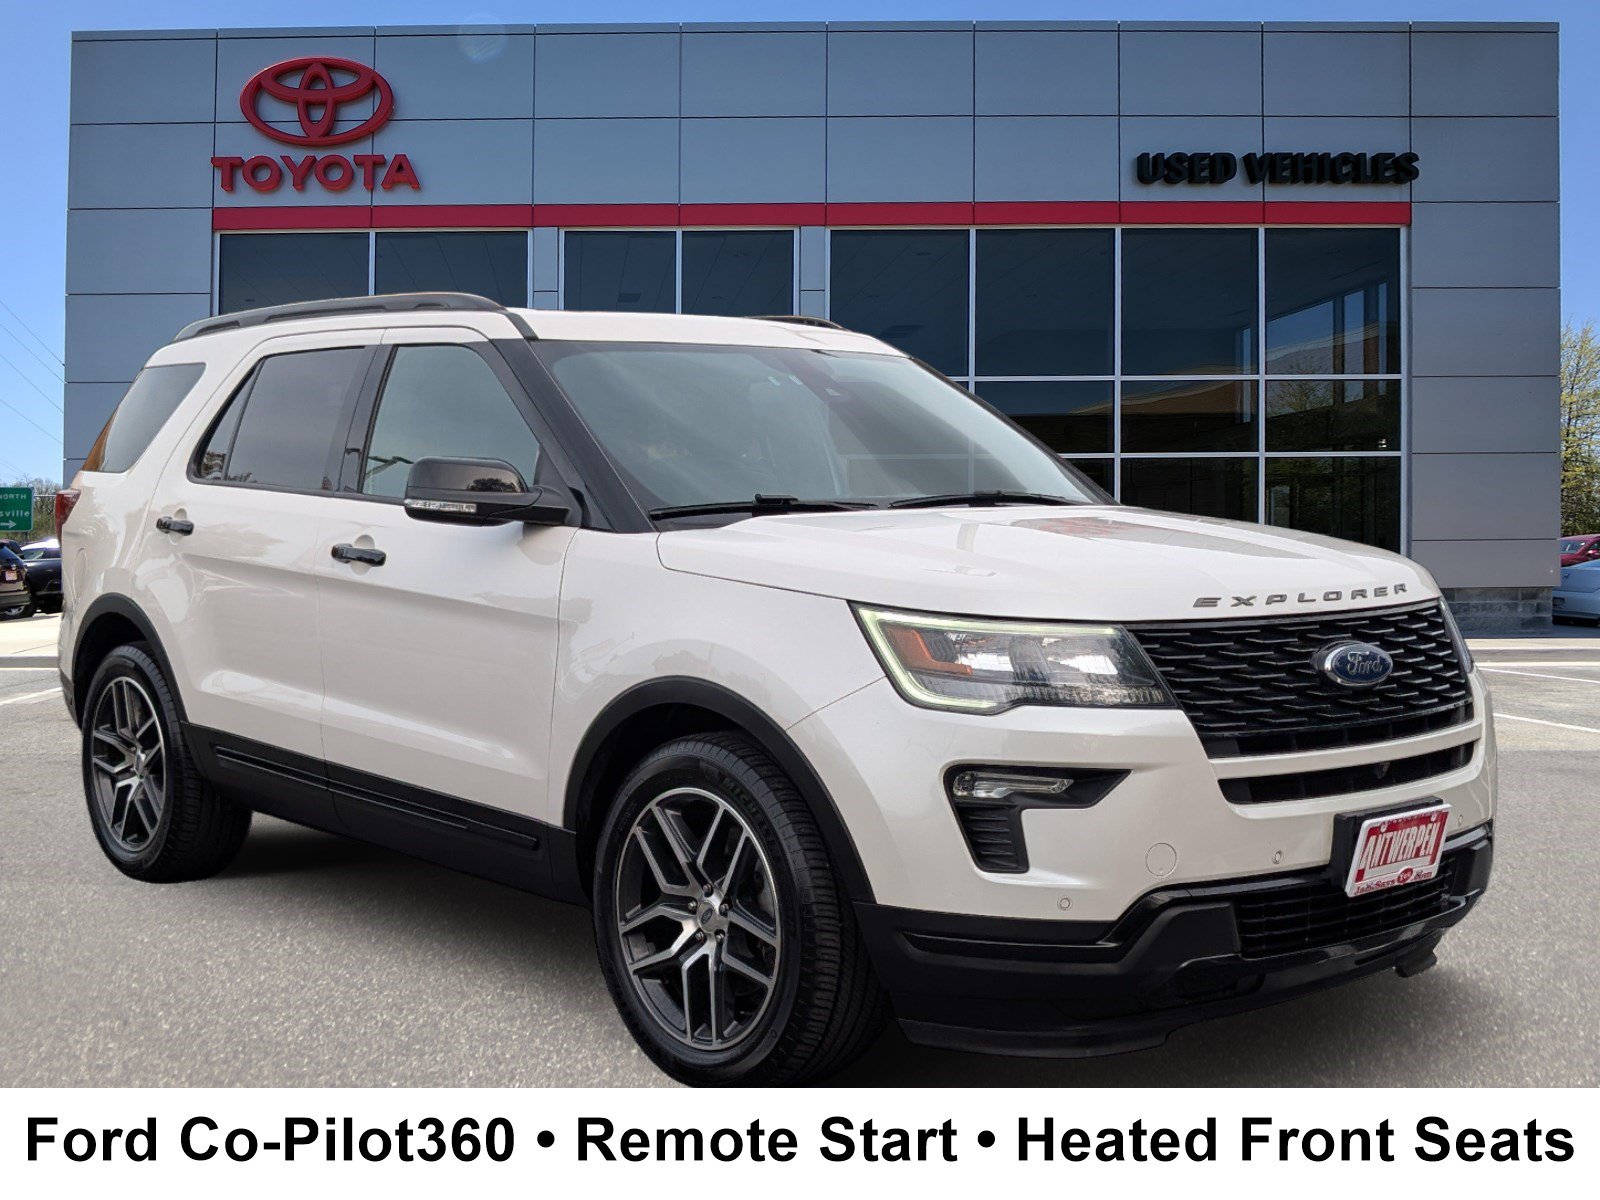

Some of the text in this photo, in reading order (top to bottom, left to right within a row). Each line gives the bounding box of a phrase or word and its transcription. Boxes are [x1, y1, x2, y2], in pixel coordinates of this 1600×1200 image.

[211, 154, 420, 191] TOYOTA
[1136, 152, 1420, 185] USED VEHICLES
[1193, 583, 1408, 608] EXPLORER
[1346, 650, 1384, 676] Ford
